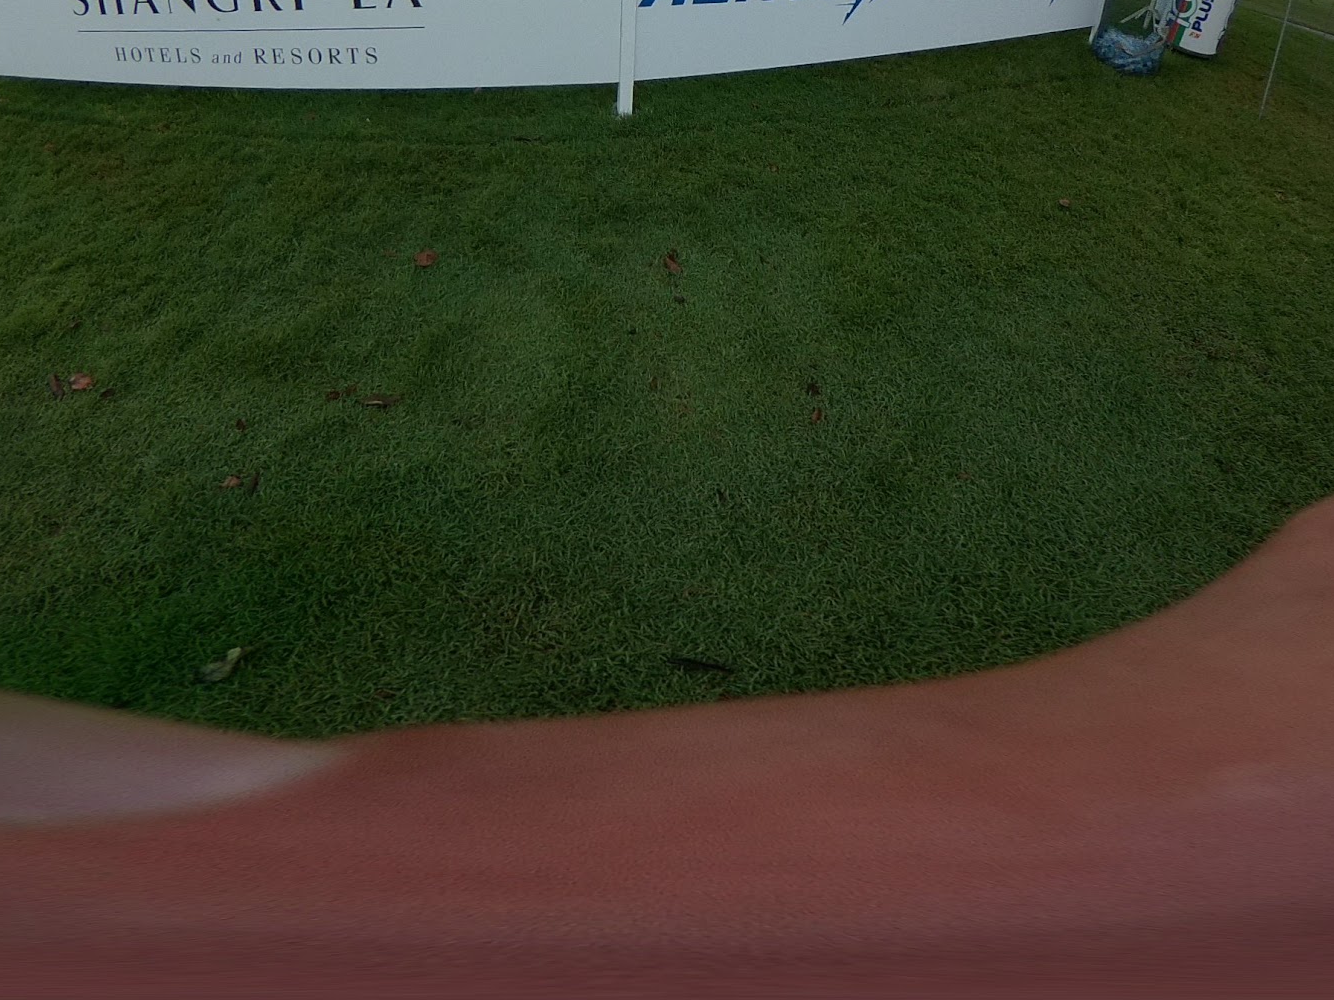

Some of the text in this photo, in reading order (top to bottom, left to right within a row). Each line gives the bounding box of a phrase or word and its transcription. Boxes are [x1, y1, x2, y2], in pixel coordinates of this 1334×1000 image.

[115, 46, 379, 65] HOTELS and RESORTS
